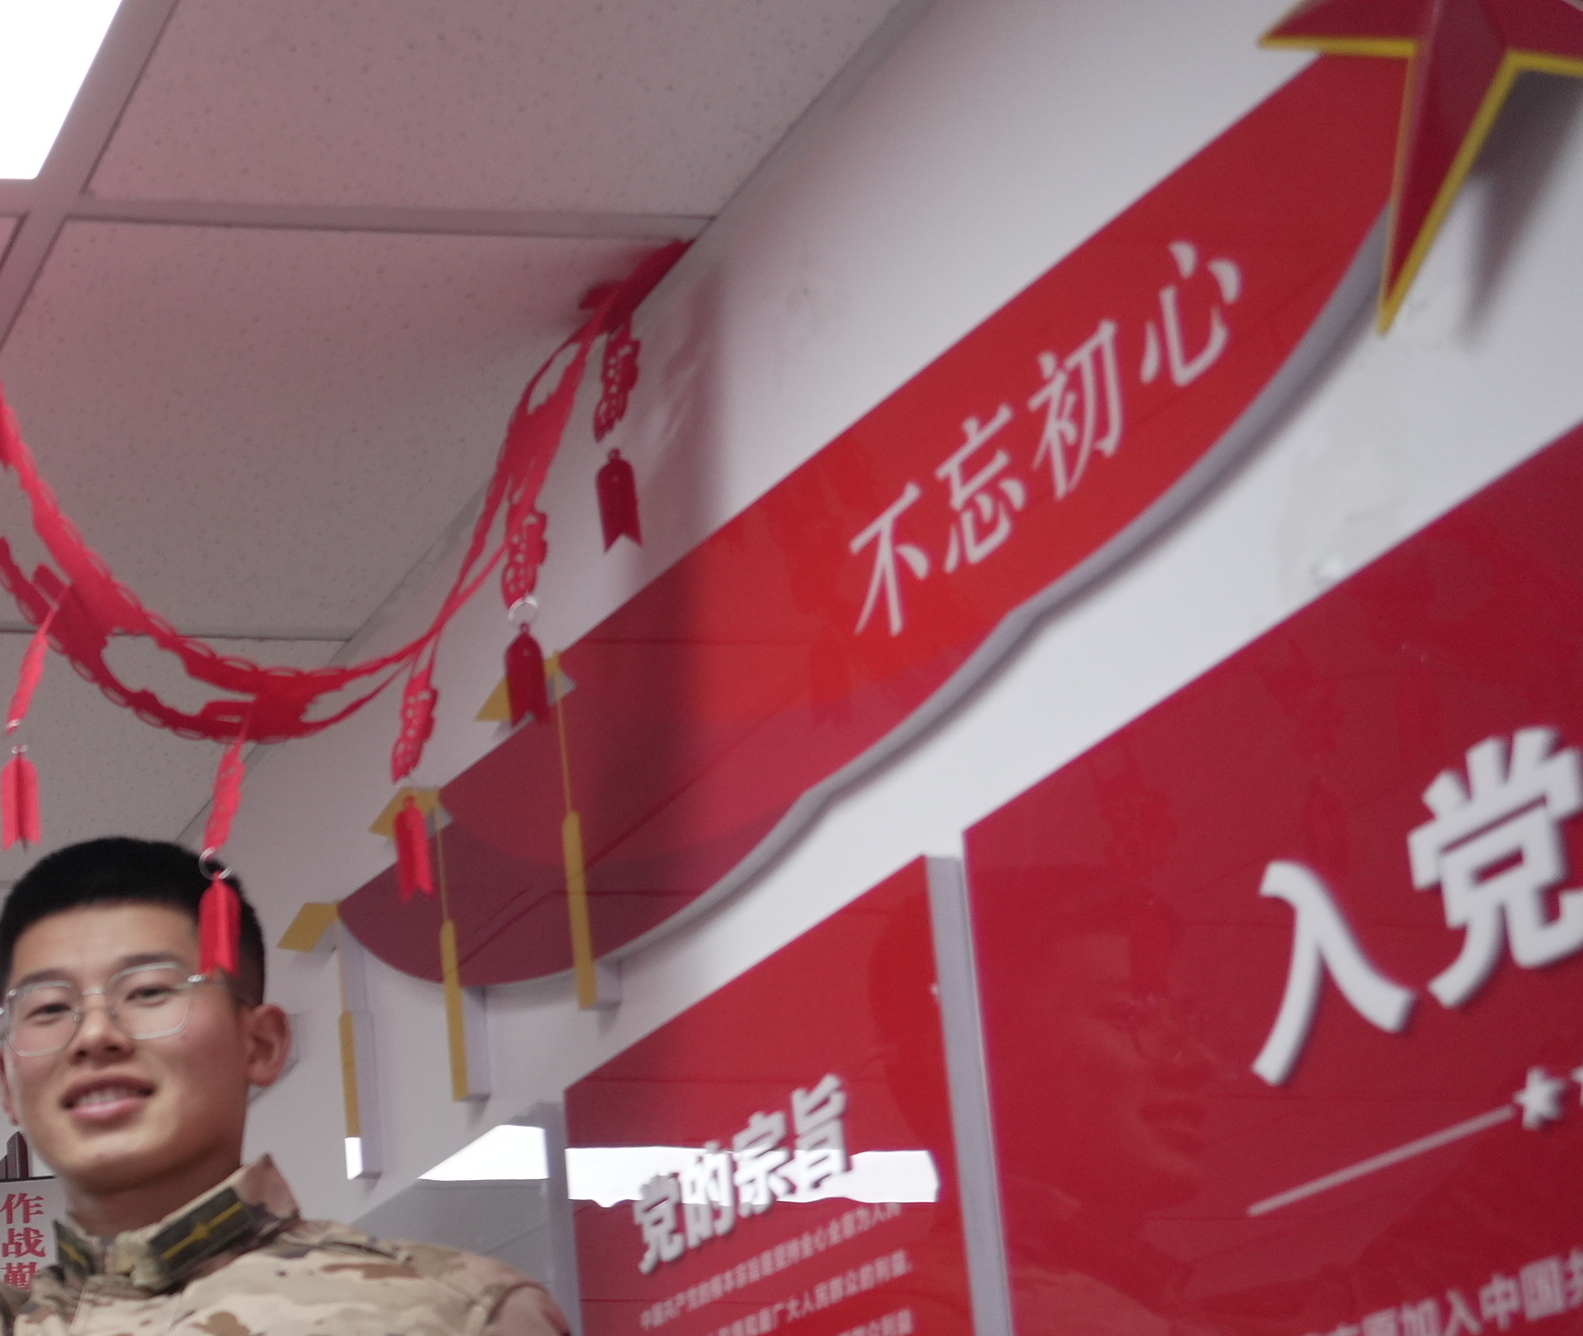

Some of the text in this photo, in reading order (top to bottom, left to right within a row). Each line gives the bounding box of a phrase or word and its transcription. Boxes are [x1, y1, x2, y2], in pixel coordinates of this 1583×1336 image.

[849, 240, 1241, 637] 不忘初心
[1252, 725, 1583, 1087] 入党
[634, 1072, 853, 1275] 党的宗旨
